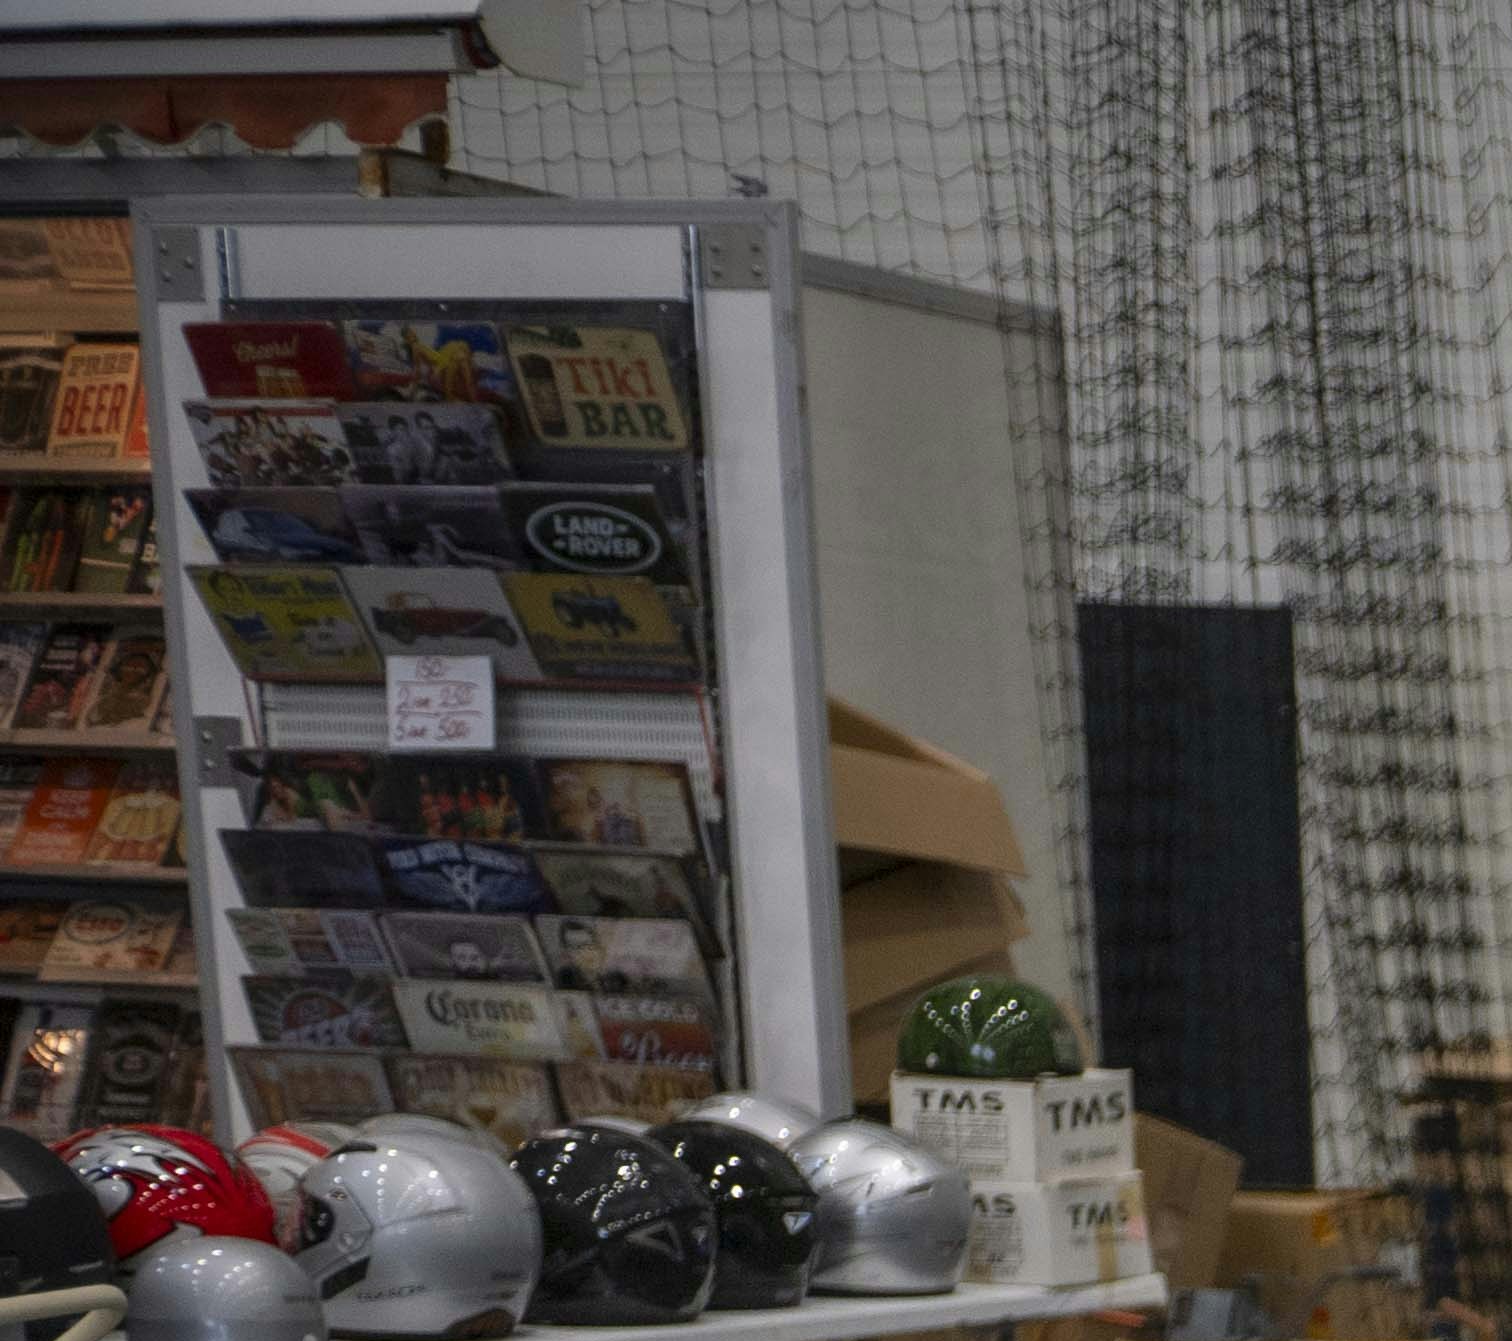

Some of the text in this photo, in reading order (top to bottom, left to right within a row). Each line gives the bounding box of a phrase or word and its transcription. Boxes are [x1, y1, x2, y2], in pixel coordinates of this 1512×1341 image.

[56, 384, 128, 437] BEER
[575, 402, 675, 440] BAR
[425, 987, 537, 1027] Corona
[913, 1087, 1005, 1112] TMS
[1044, 1090, 1126, 1132] TMS
[1065, 1201, 1129, 1228] TMS
